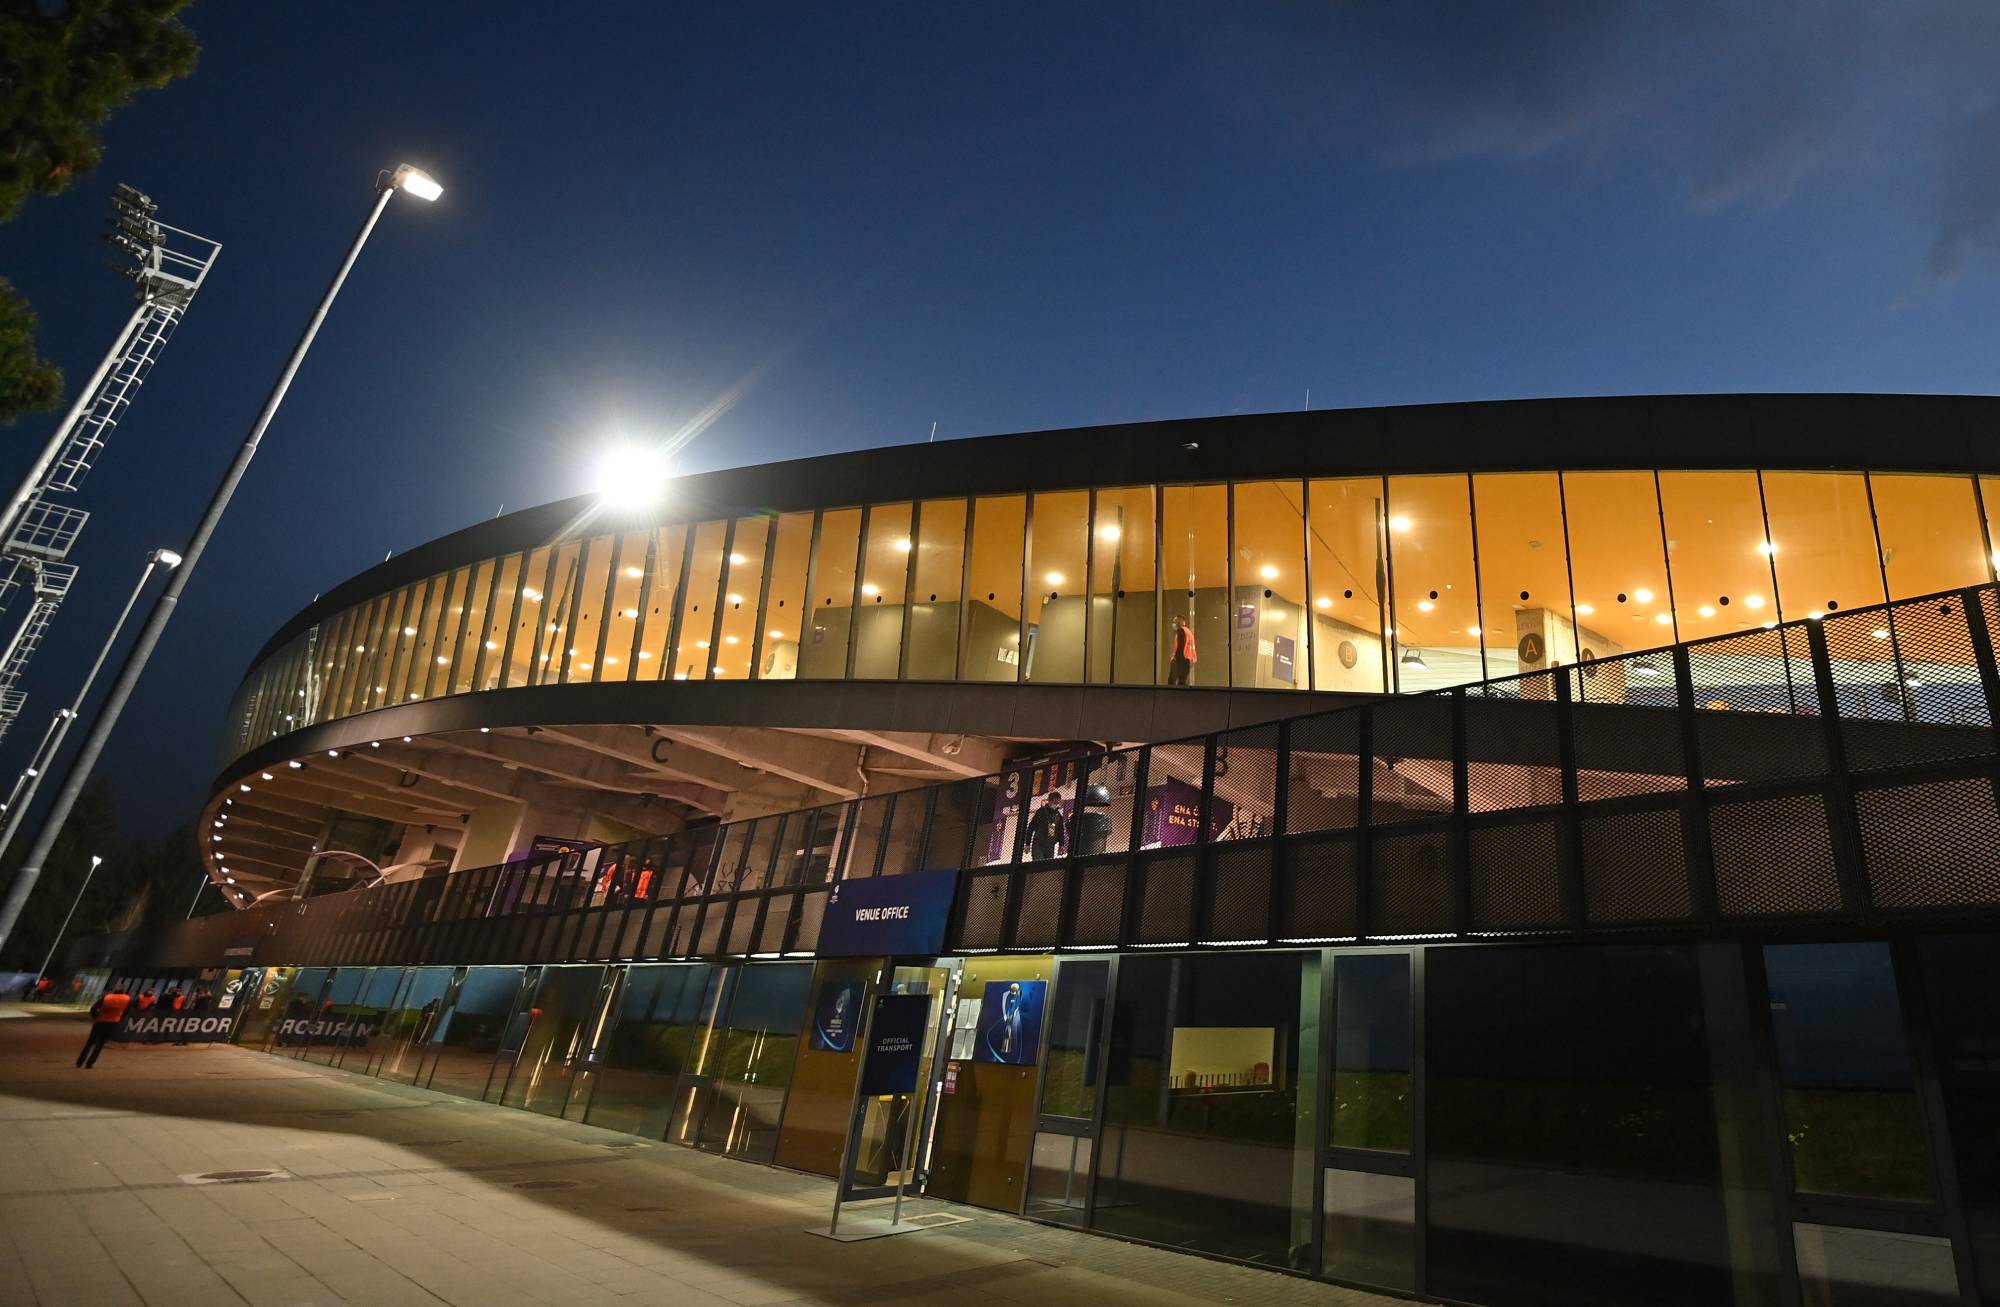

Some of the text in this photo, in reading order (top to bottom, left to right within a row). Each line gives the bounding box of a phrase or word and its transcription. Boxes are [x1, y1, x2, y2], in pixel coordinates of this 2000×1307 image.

[1236, 604, 1256, 629] B
[1345, 646, 1353, 662] B
[1525, 638, 1538, 658] A
[652, 737, 673, 763] C
[400, 770, 420, 788] D
[1005, 771, 1020, 799] 3
[1168, 815, 1185, 826] ENA
[855, 906, 910, 922] VENUE OFFICE
[124, 1017, 233, 1034] MARIBOR
[877, 1044, 913, 1052] TRANSPORT
[882, 1037, 910, 1045] OFFICIAL
